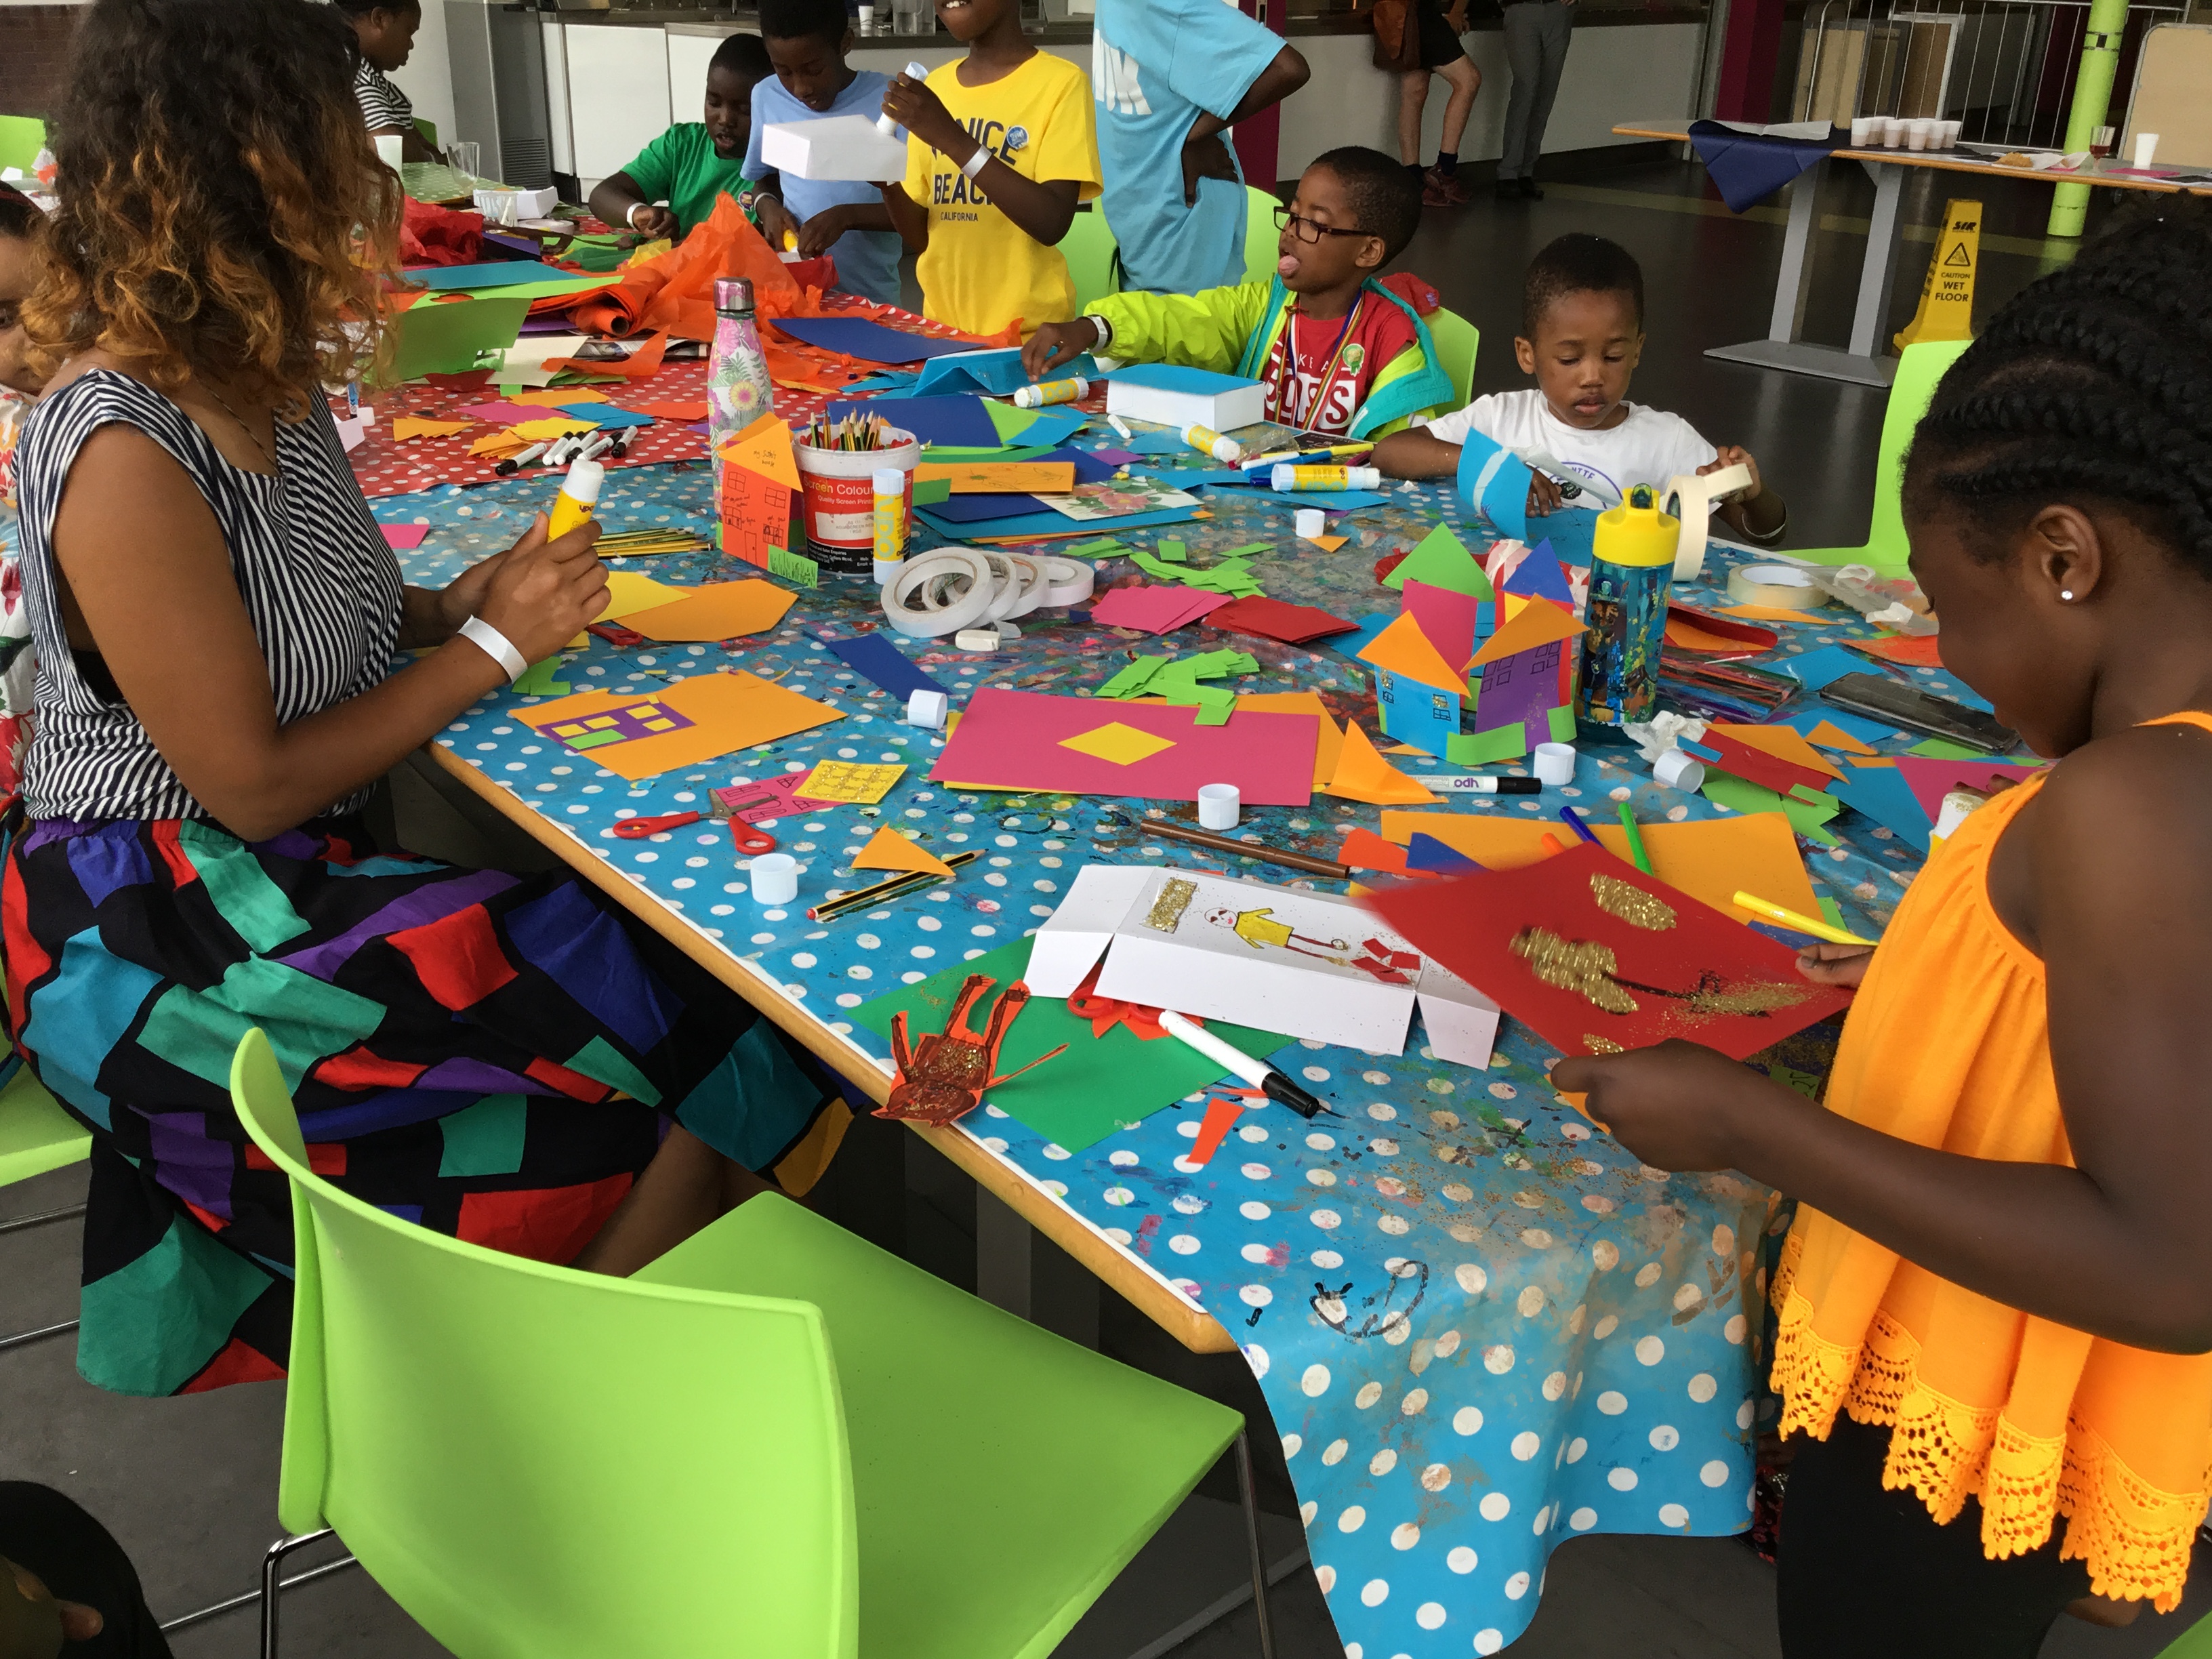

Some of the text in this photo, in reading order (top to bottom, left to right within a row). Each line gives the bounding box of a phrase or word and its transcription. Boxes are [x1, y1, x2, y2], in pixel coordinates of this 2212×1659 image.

[932, 118, 1019, 166] NICE
[934, 173, 993, 205] BEAC
[940, 211, 978, 222] CALIFORNIA
[1952, 221, 1977, 230] SIR
[1943, 281, 1965, 290] WET
[1935, 293, 1969, 302] FLOOR
[803, 476, 834, 494] Screen
[817, 495, 835, 505] Quality
